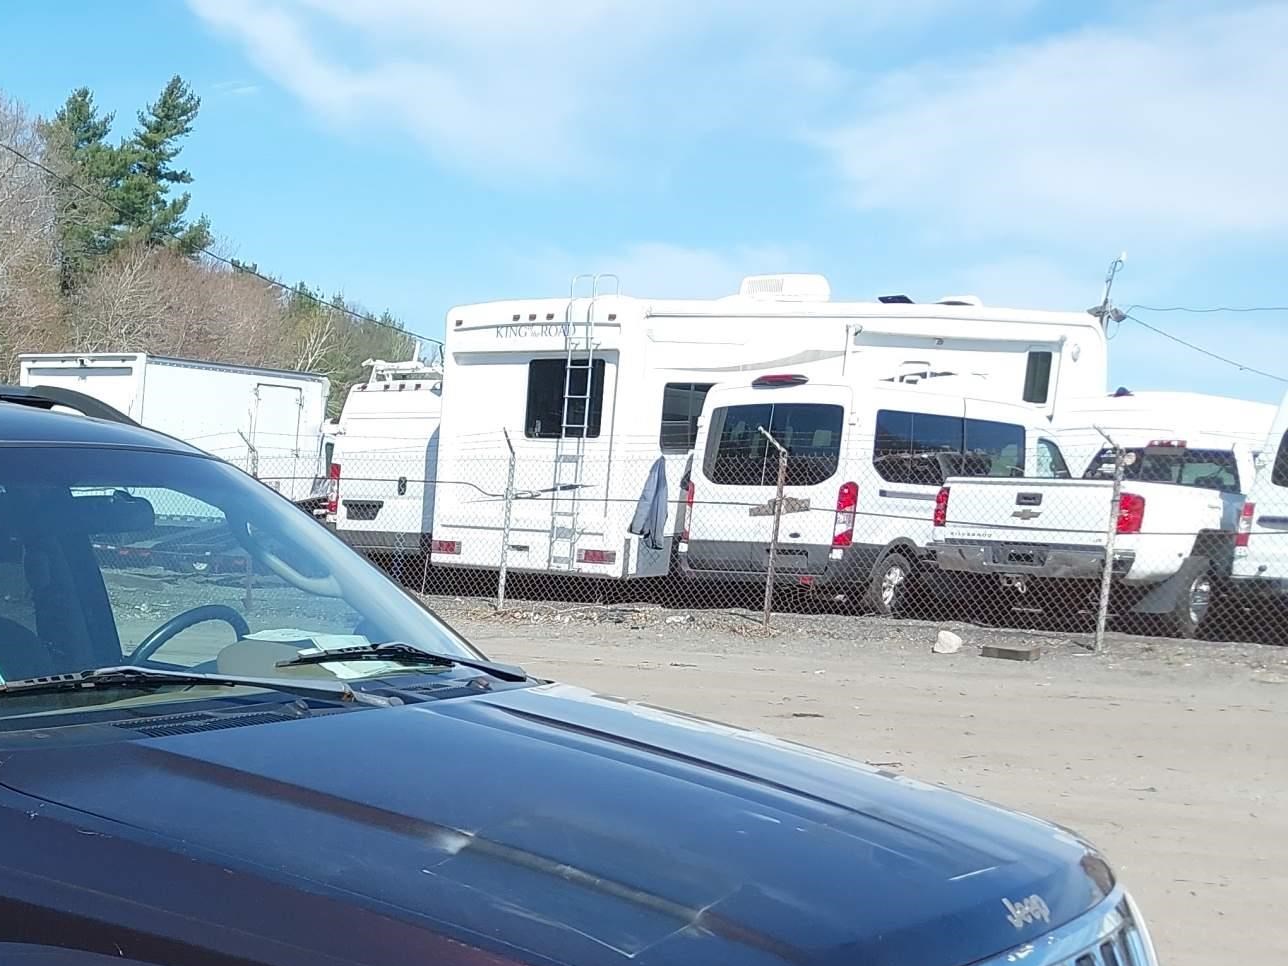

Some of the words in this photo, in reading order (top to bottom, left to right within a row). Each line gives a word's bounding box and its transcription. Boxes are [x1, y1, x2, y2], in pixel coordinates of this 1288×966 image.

[496, 326, 526, 338] KING
[540, 324, 576, 337] ROAD
[1002, 894, 1050, 928] Jeep
